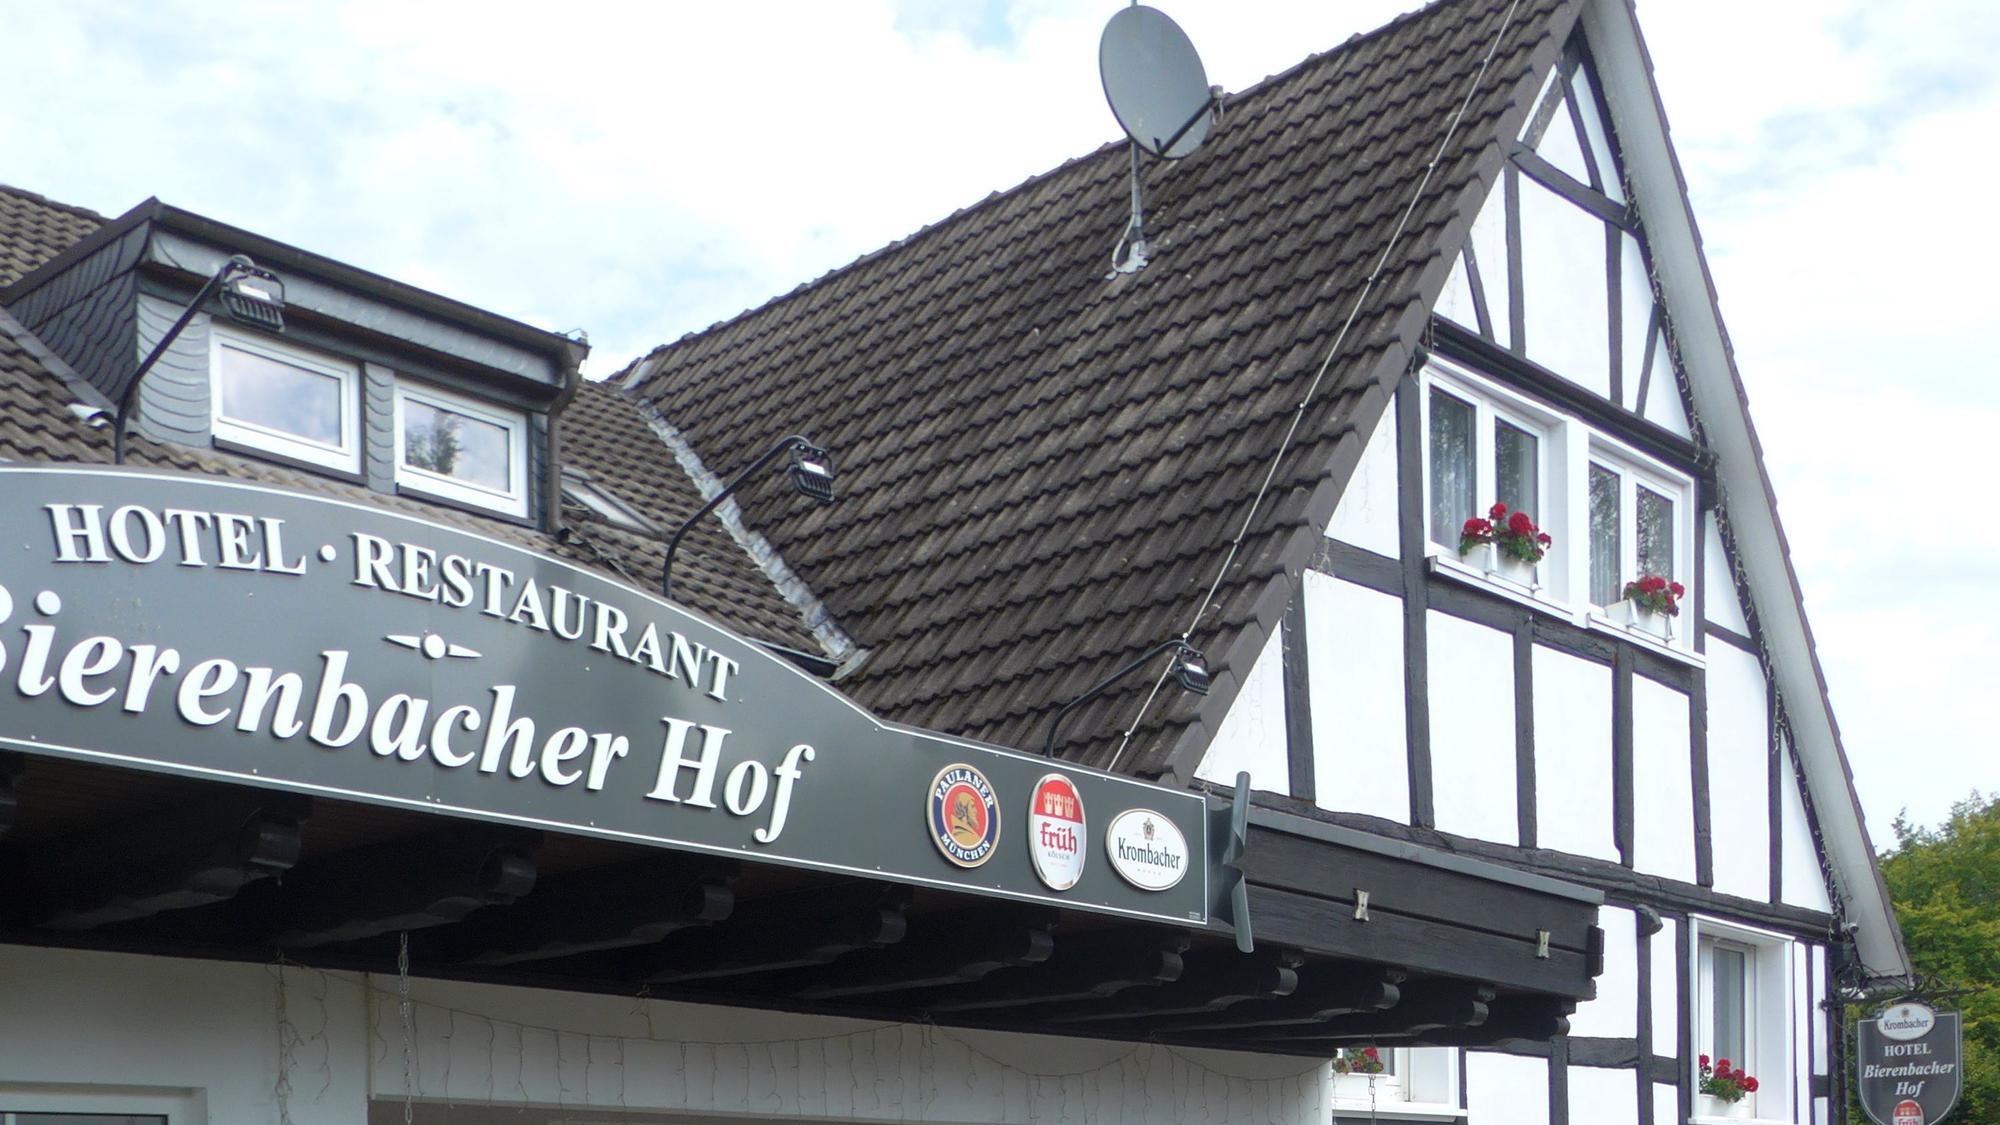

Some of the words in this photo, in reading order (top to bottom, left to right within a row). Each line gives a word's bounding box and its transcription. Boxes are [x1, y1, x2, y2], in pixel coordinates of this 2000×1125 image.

[46, 503, 306, 576] HOTEL
[352, 531, 740, 702] RESTAURANT
[644, 716, 816, 843] Hof
[935, 769, 994, 809] PAULANER
[1118, 836, 1181, 870] Krombacher
[1883, 1018, 1929, 1031] Krombacher
[1884, 1043, 1932, 1057] HOTEL
[1864, 1061, 1955, 1078] Bierenbacher
[1895, 1081, 1925, 1098] Hof
